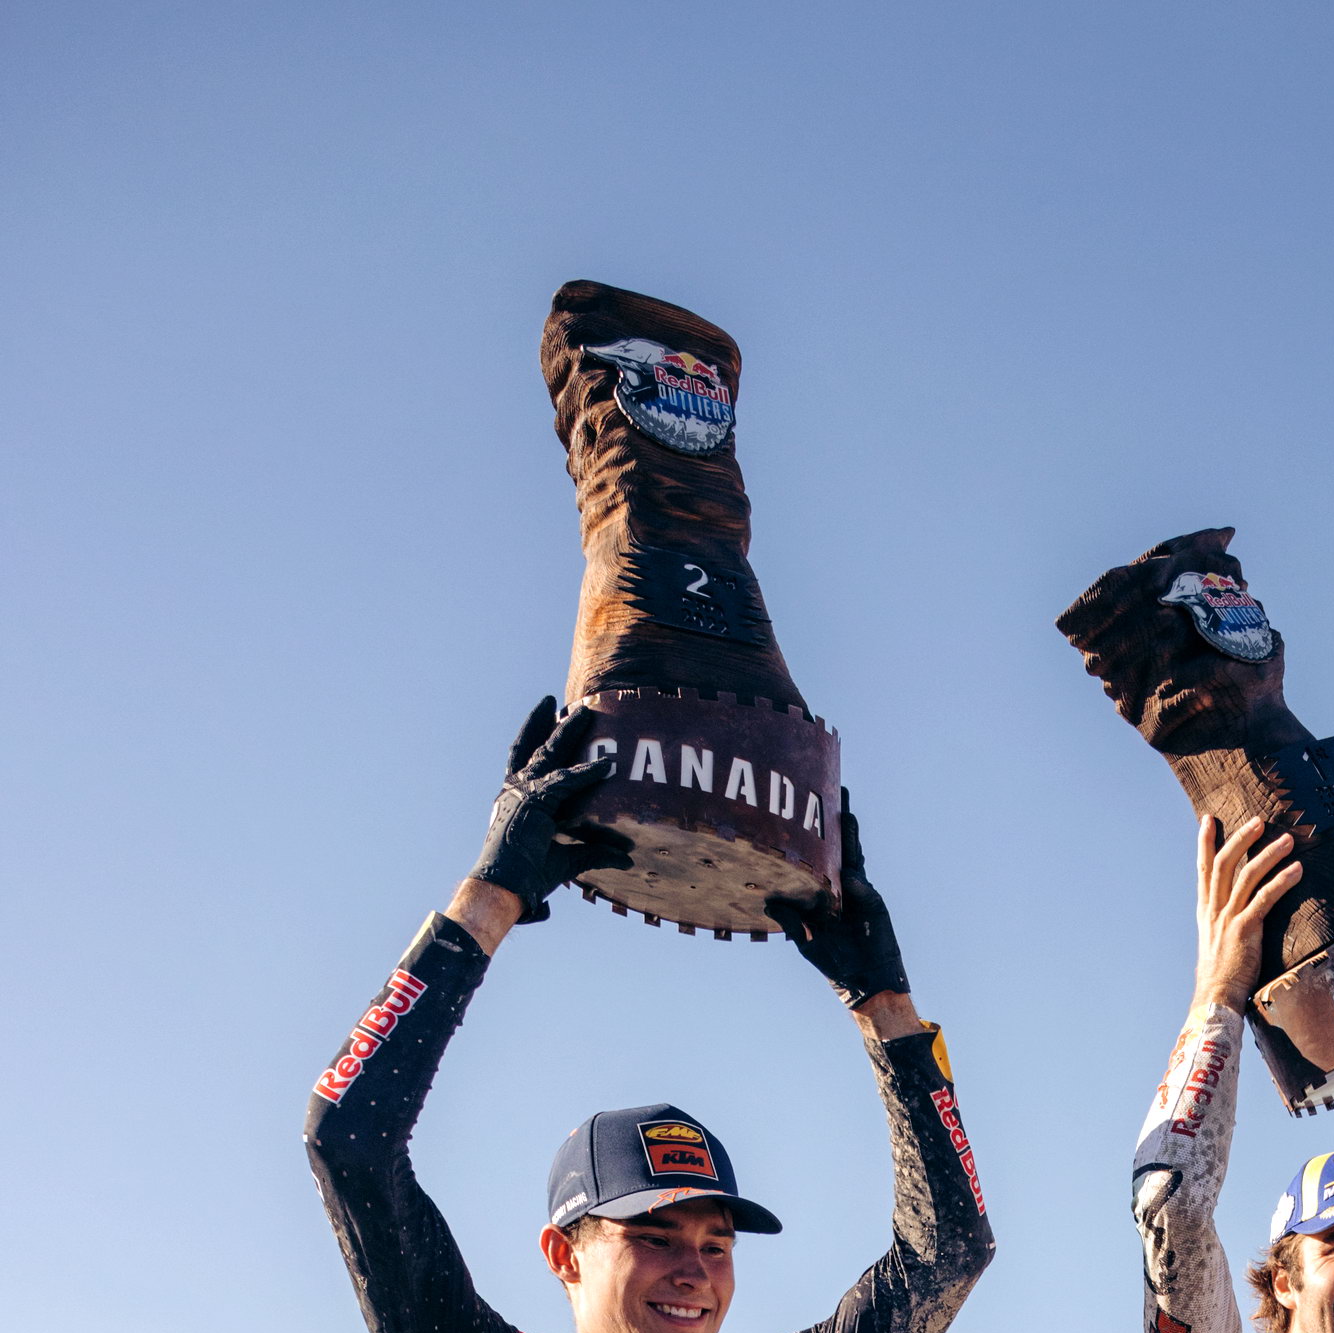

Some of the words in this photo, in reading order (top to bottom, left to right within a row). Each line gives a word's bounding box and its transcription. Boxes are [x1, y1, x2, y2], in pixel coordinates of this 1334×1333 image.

[654, 365, 691, 392] Red
[693, 375, 731, 404] Bull
[658, 384, 731, 422] OUTLIERS
[589, 737, 826, 840] CANADA
[312, 1027, 382, 1104] Red
[359, 968, 428, 1039] Bull
[1191, 1041, 1232, 1089] Bull
[651, 1125, 703, 1141] FMF
[1171, 1086, 1213, 1138] Red
[661, 1150, 705, 1167] KTM
[929, 1085, 971, 1153] Red
[959, 1151, 987, 1216] Bull
